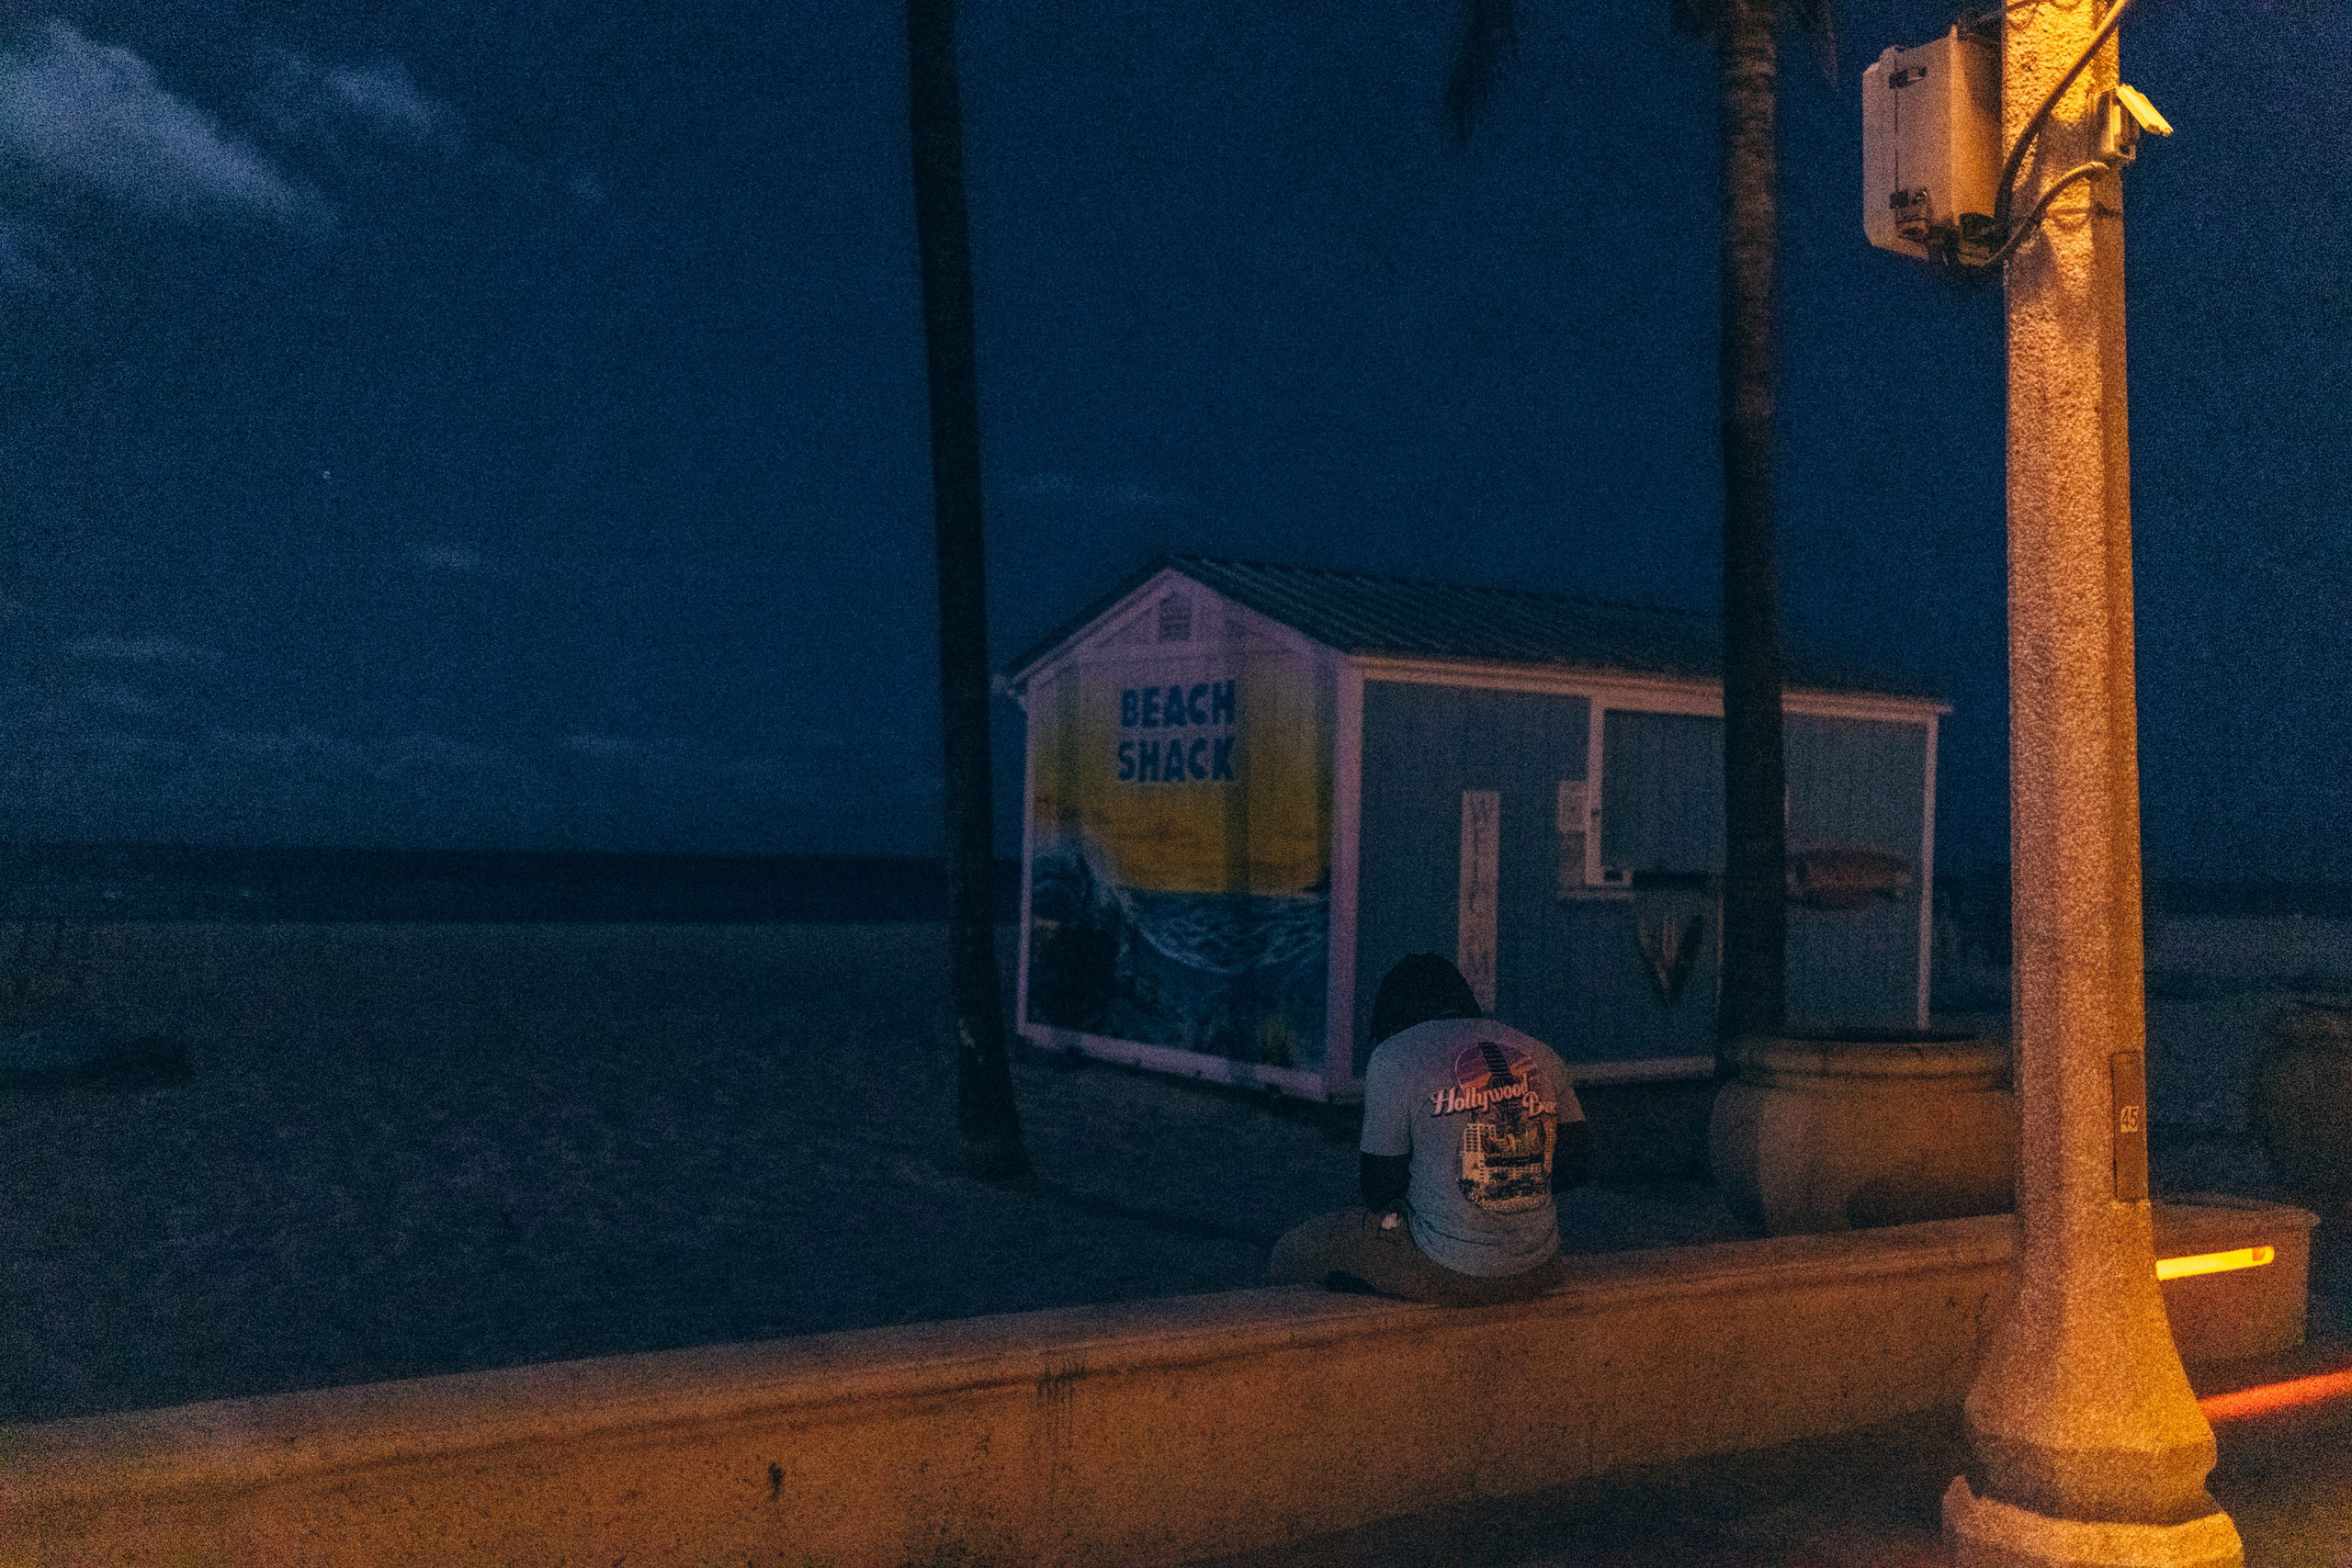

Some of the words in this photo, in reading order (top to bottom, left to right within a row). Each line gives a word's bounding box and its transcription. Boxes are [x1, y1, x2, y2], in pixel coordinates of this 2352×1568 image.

[1121, 680, 1236, 728] BEACH
[1118, 736, 1235, 783] SHACK
[1430, 1072, 1529, 1117] Hollywood
[2121, 1107, 2138, 1129] 45
